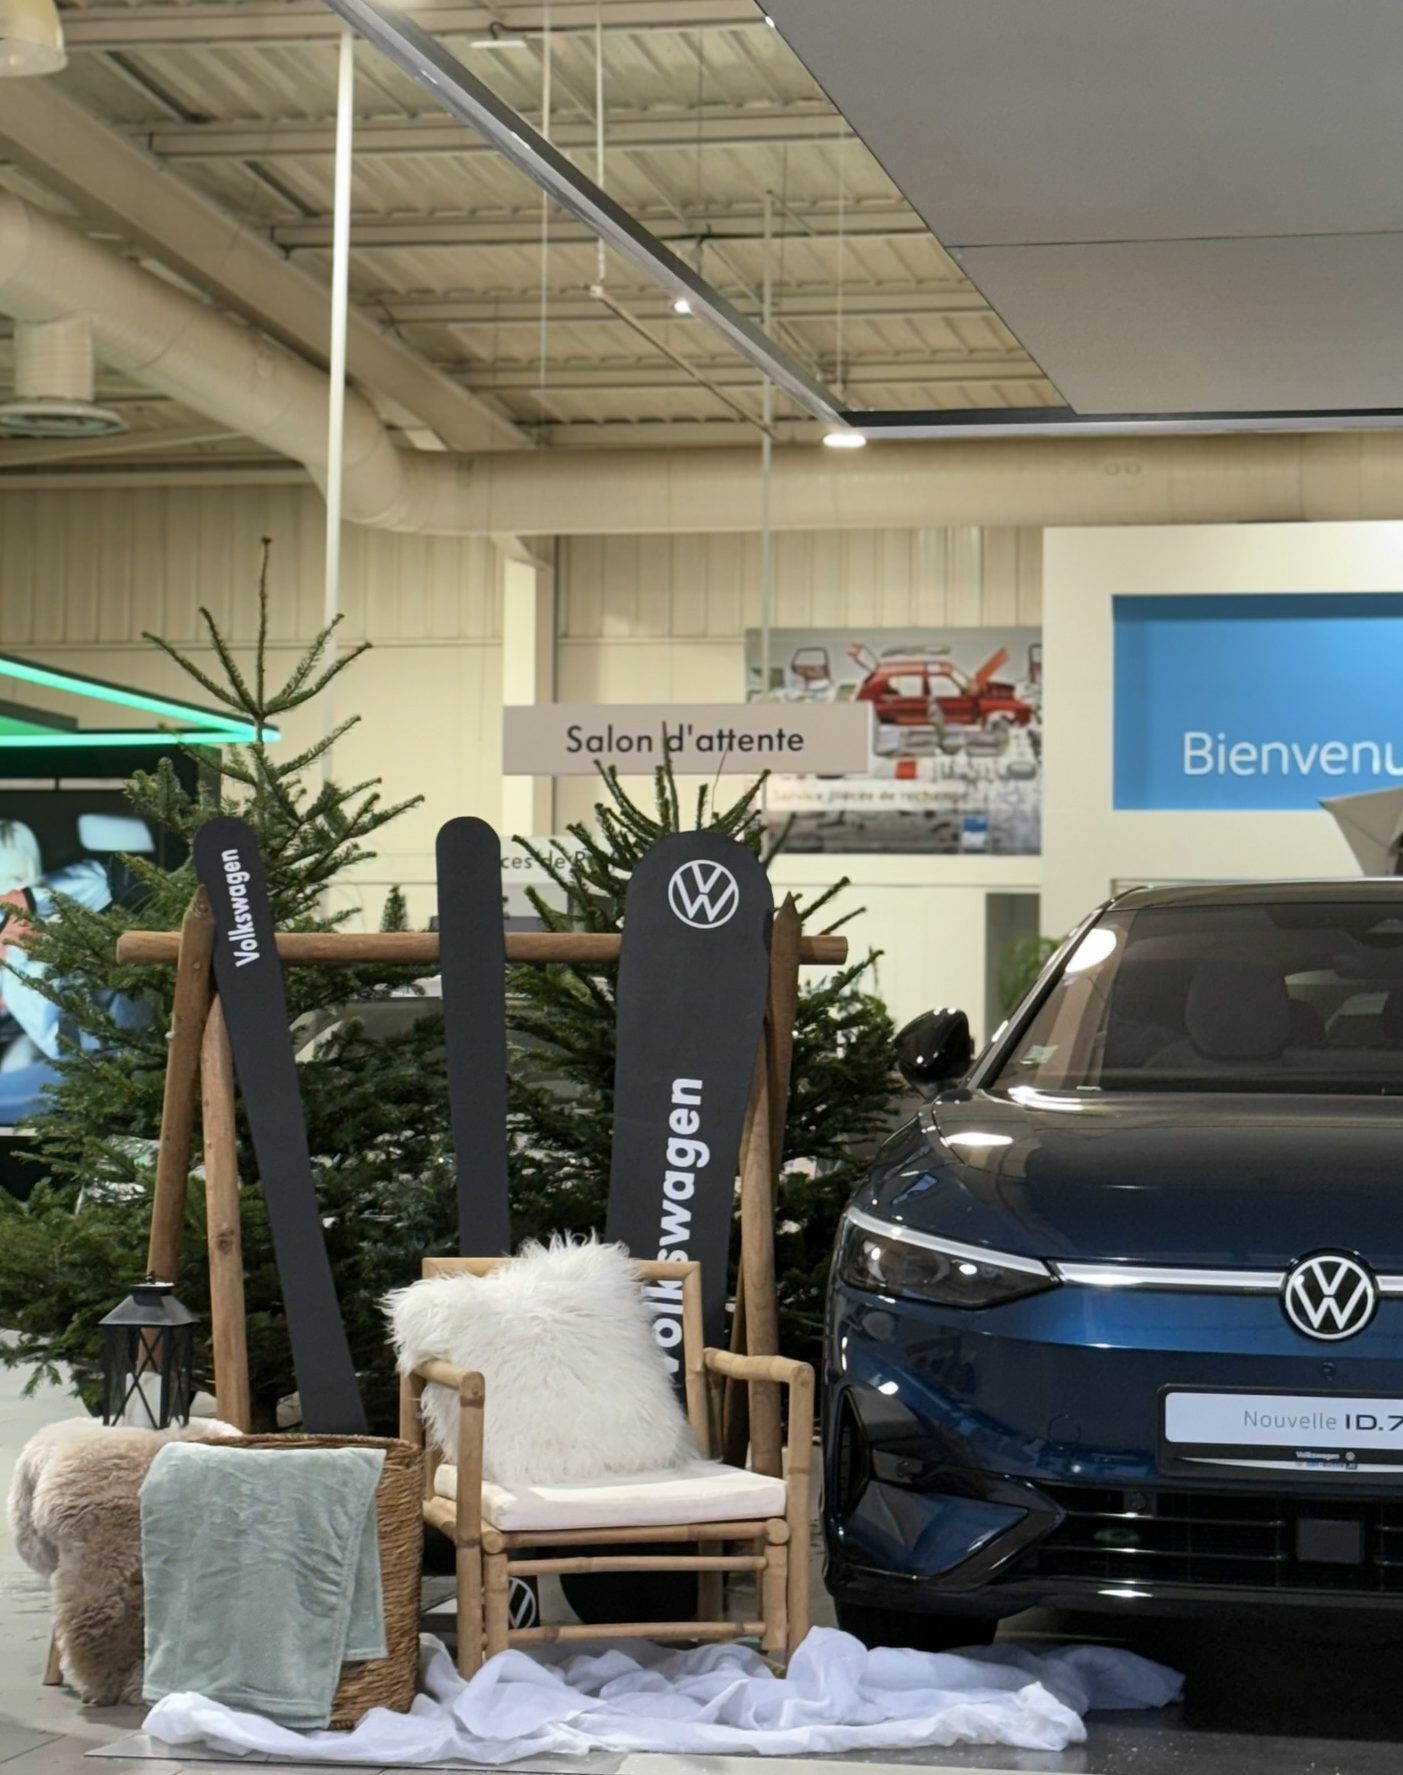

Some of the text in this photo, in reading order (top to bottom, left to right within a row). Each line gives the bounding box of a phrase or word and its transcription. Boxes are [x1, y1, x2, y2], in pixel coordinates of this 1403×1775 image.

[566, 723, 804, 753] Salon d'attente
[1183, 731, 1403, 776] Bienvenu
[221, 848, 260, 968] Volkswagen
[1243, 1410, 1403, 1431] Nouvelle ID.7
